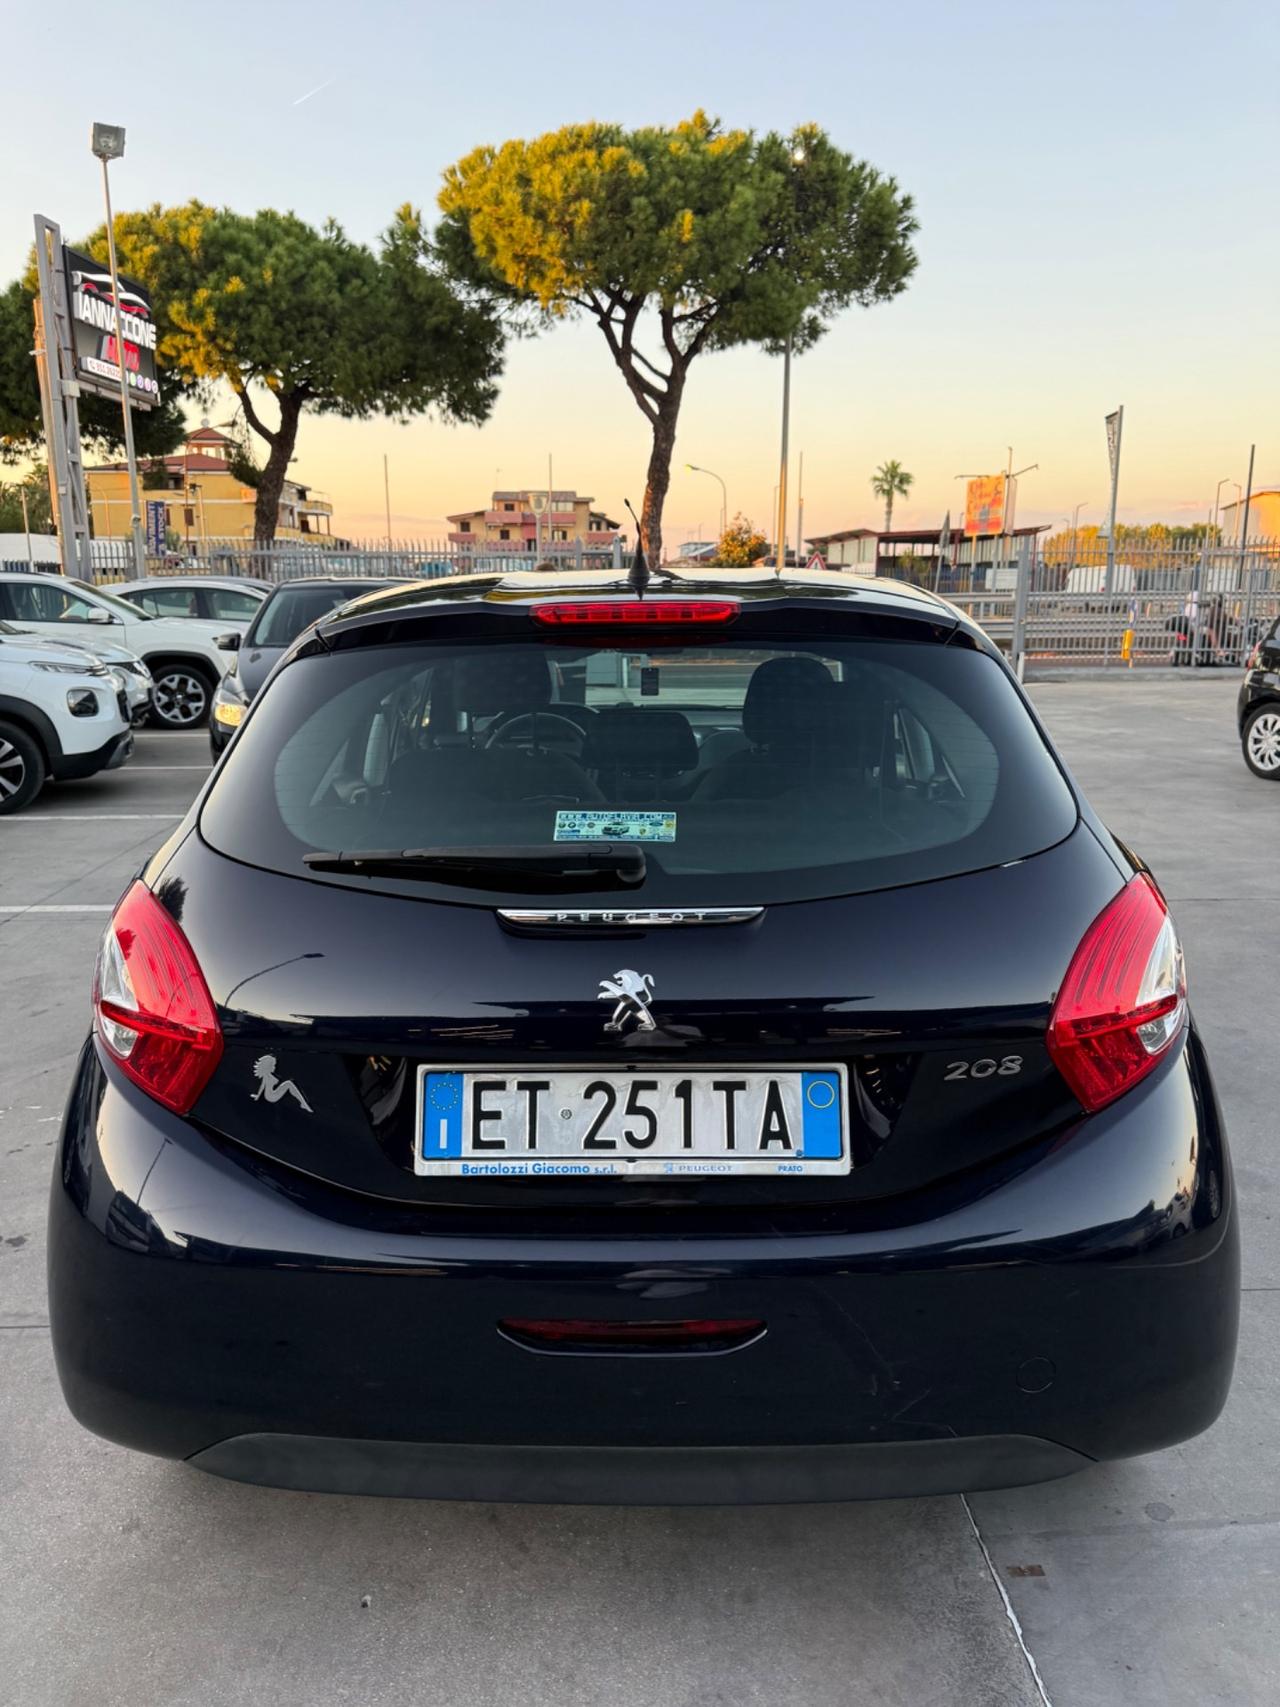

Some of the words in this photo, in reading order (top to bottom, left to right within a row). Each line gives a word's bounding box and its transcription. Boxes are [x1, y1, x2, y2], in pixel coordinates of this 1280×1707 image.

[556, 912, 706, 922] PEUGEOT
[944, 1055, 1023, 1080] 208
[472, 1080, 550, 1150] ET
[582, 1080, 792, 1150] 251TA
[462, 1163, 528, 1174] Bartolozzi
[532, 1163, 590, 1174] Giacomo
[594, 1163, 617, 1174] s.r.l.
